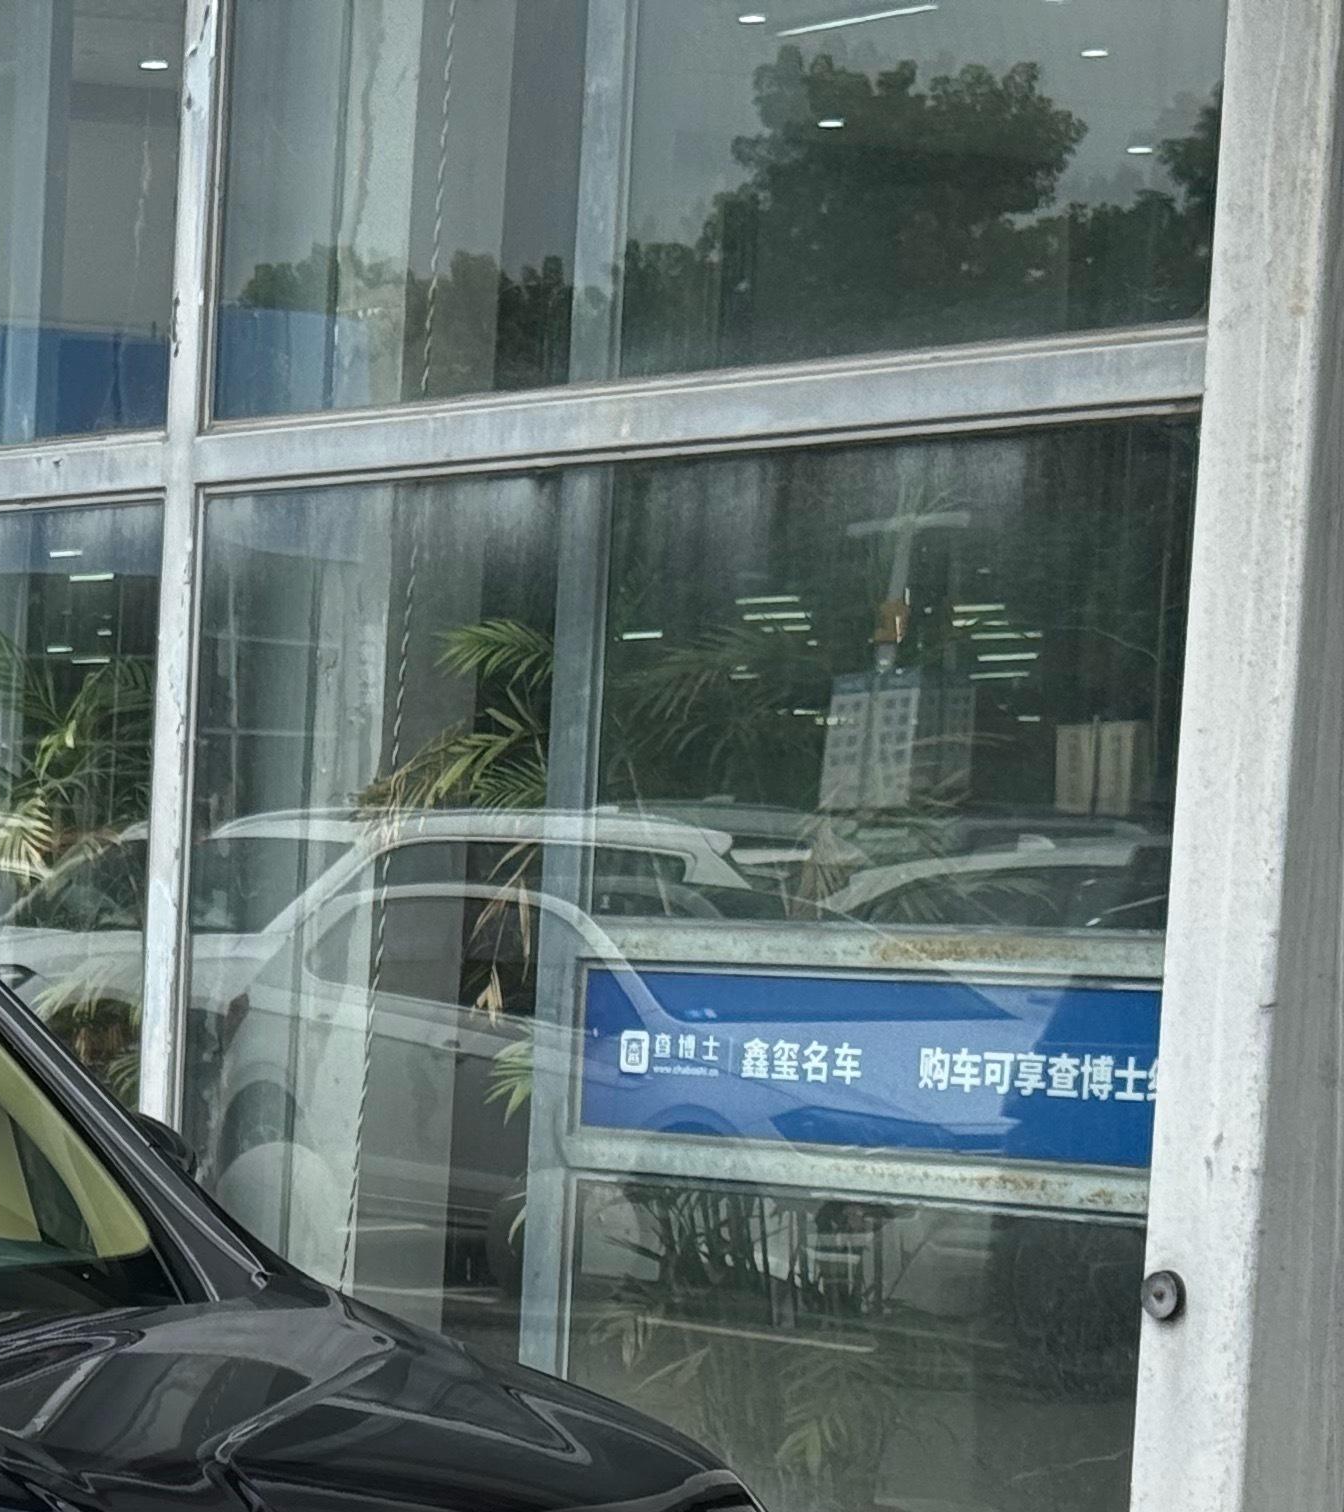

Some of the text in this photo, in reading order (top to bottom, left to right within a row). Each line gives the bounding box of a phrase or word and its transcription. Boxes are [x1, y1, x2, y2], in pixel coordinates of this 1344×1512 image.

[653, 1032, 721, 1062] 查博士
[740, 1037, 864, 1086] 鑫玺名车
